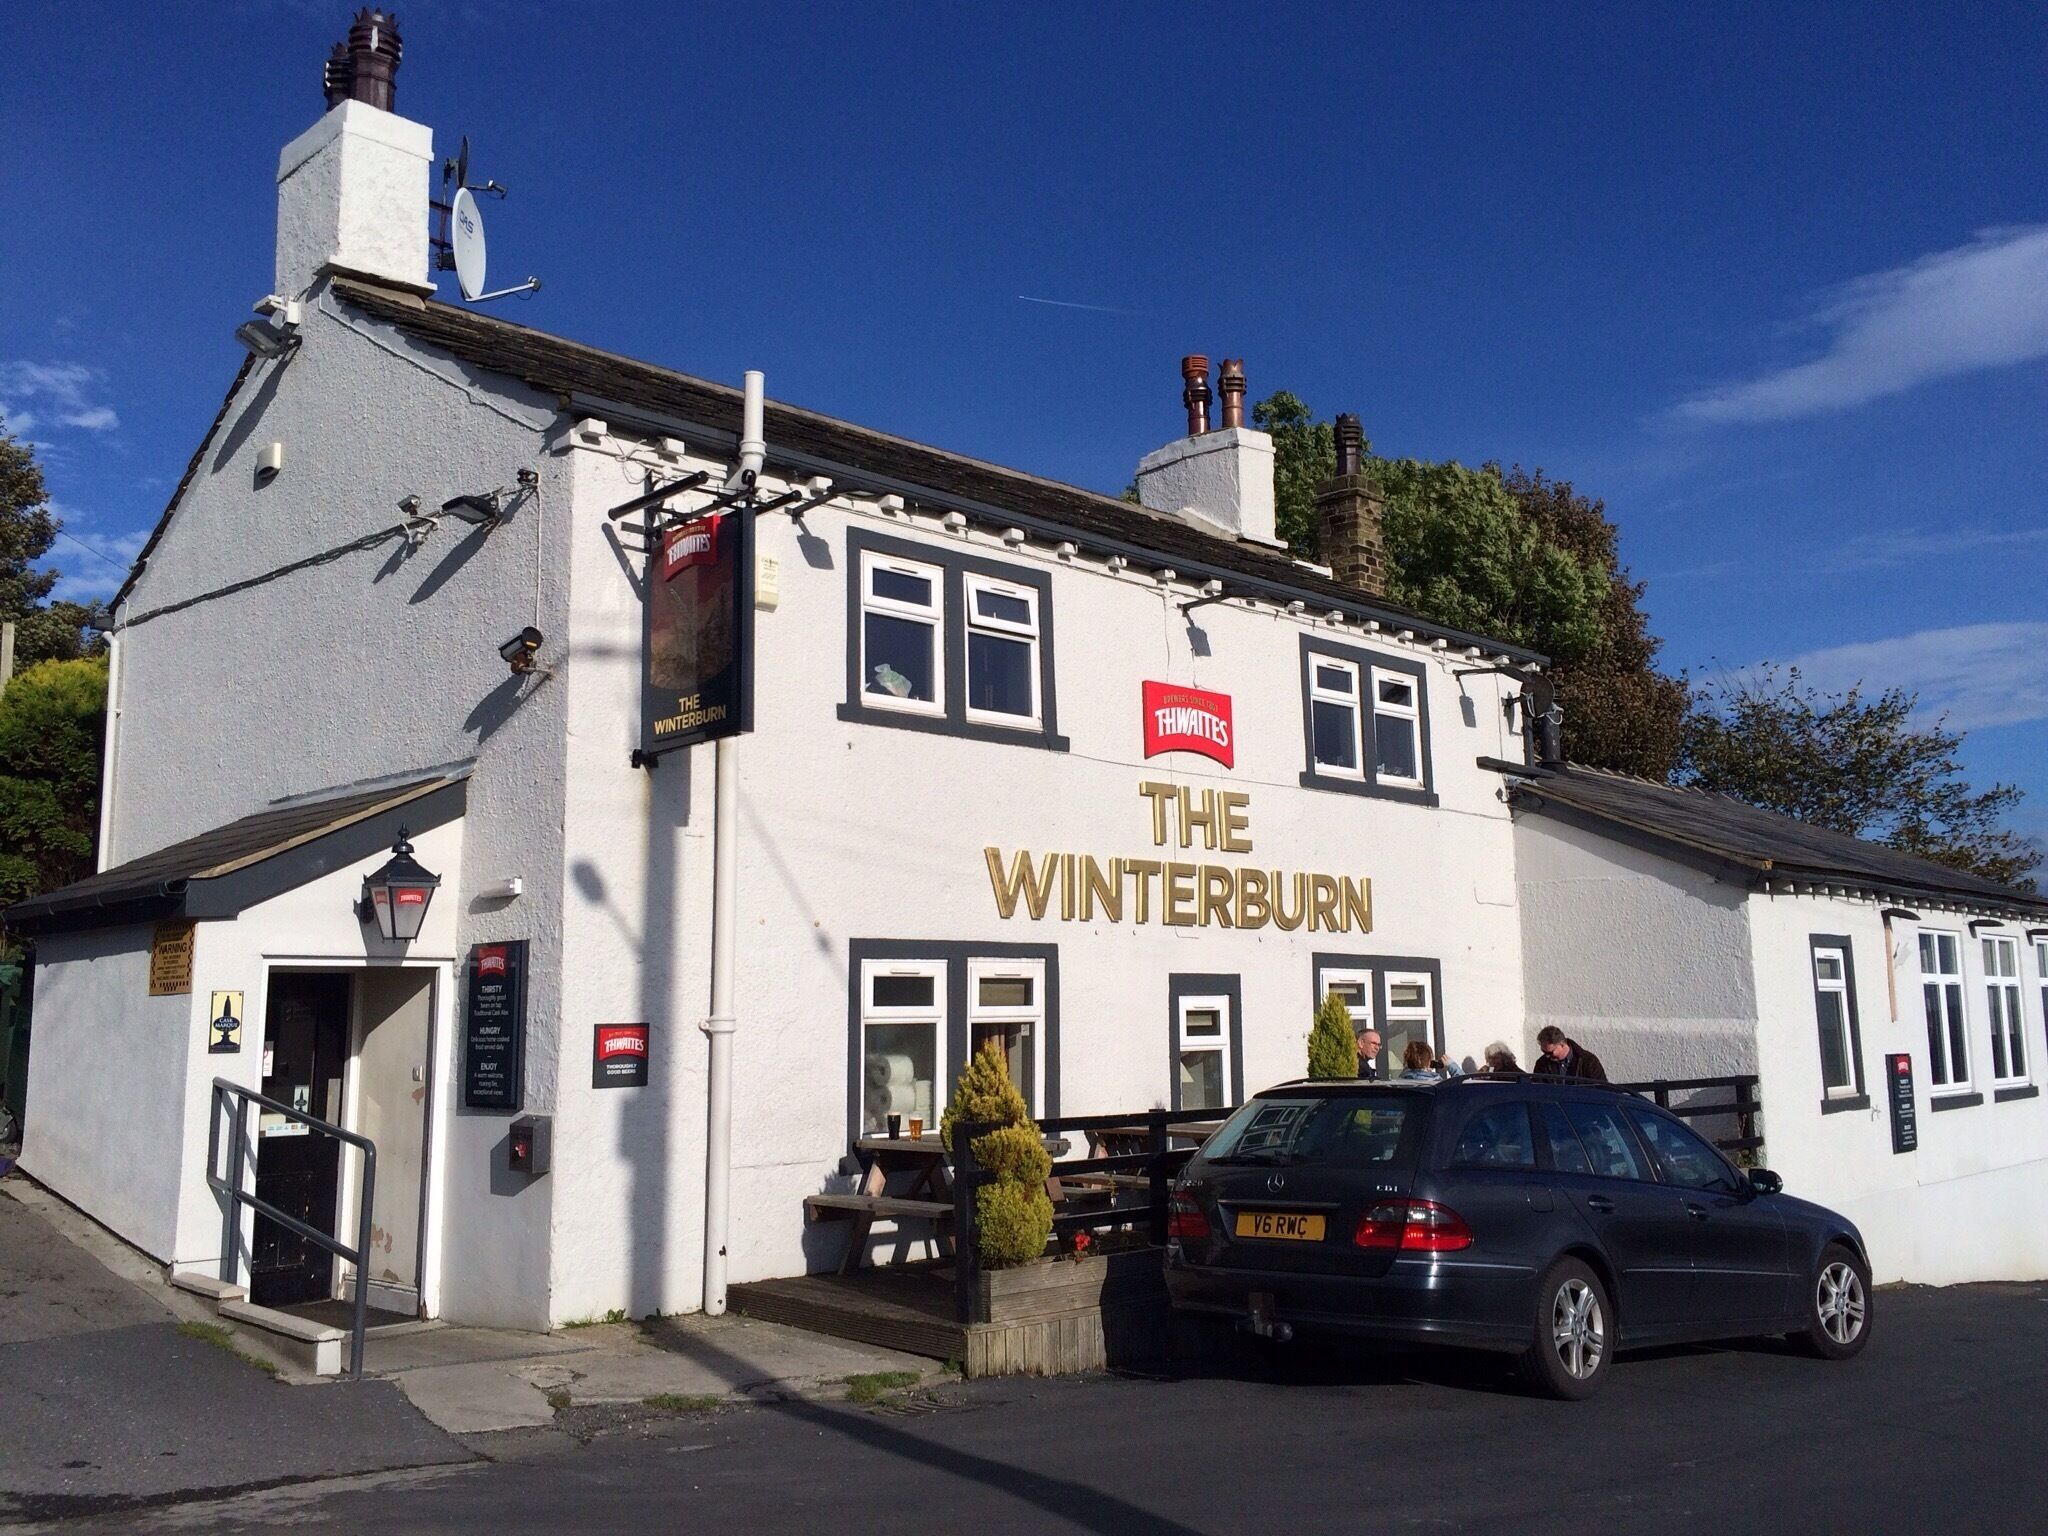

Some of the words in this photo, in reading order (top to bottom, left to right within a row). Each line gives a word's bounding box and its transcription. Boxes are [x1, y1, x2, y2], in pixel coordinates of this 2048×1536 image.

[666, 533, 711, 566] THWAITES
[678, 692, 701, 713] THE
[654, 704, 727, 736] WINTERBURN
[1154, 706, 1229, 748] THWAITES
[1138, 779, 1253, 855] THE
[983, 845, 1373, 934] WINTERBURN
[157, 942, 187, 955] WARNING
[480, 956, 505, 971] THWAITES
[481, 985, 502, 993] THIRSTY
[479, 1027, 501, 1035] HUNGRY
[604, 1036, 644, 1053] THWAITES
[480, 1062, 498, 1071] ENJOY
[1254, 1215, 1272, 1234] V6
[1276, 1215, 1307, 1236] RWC
